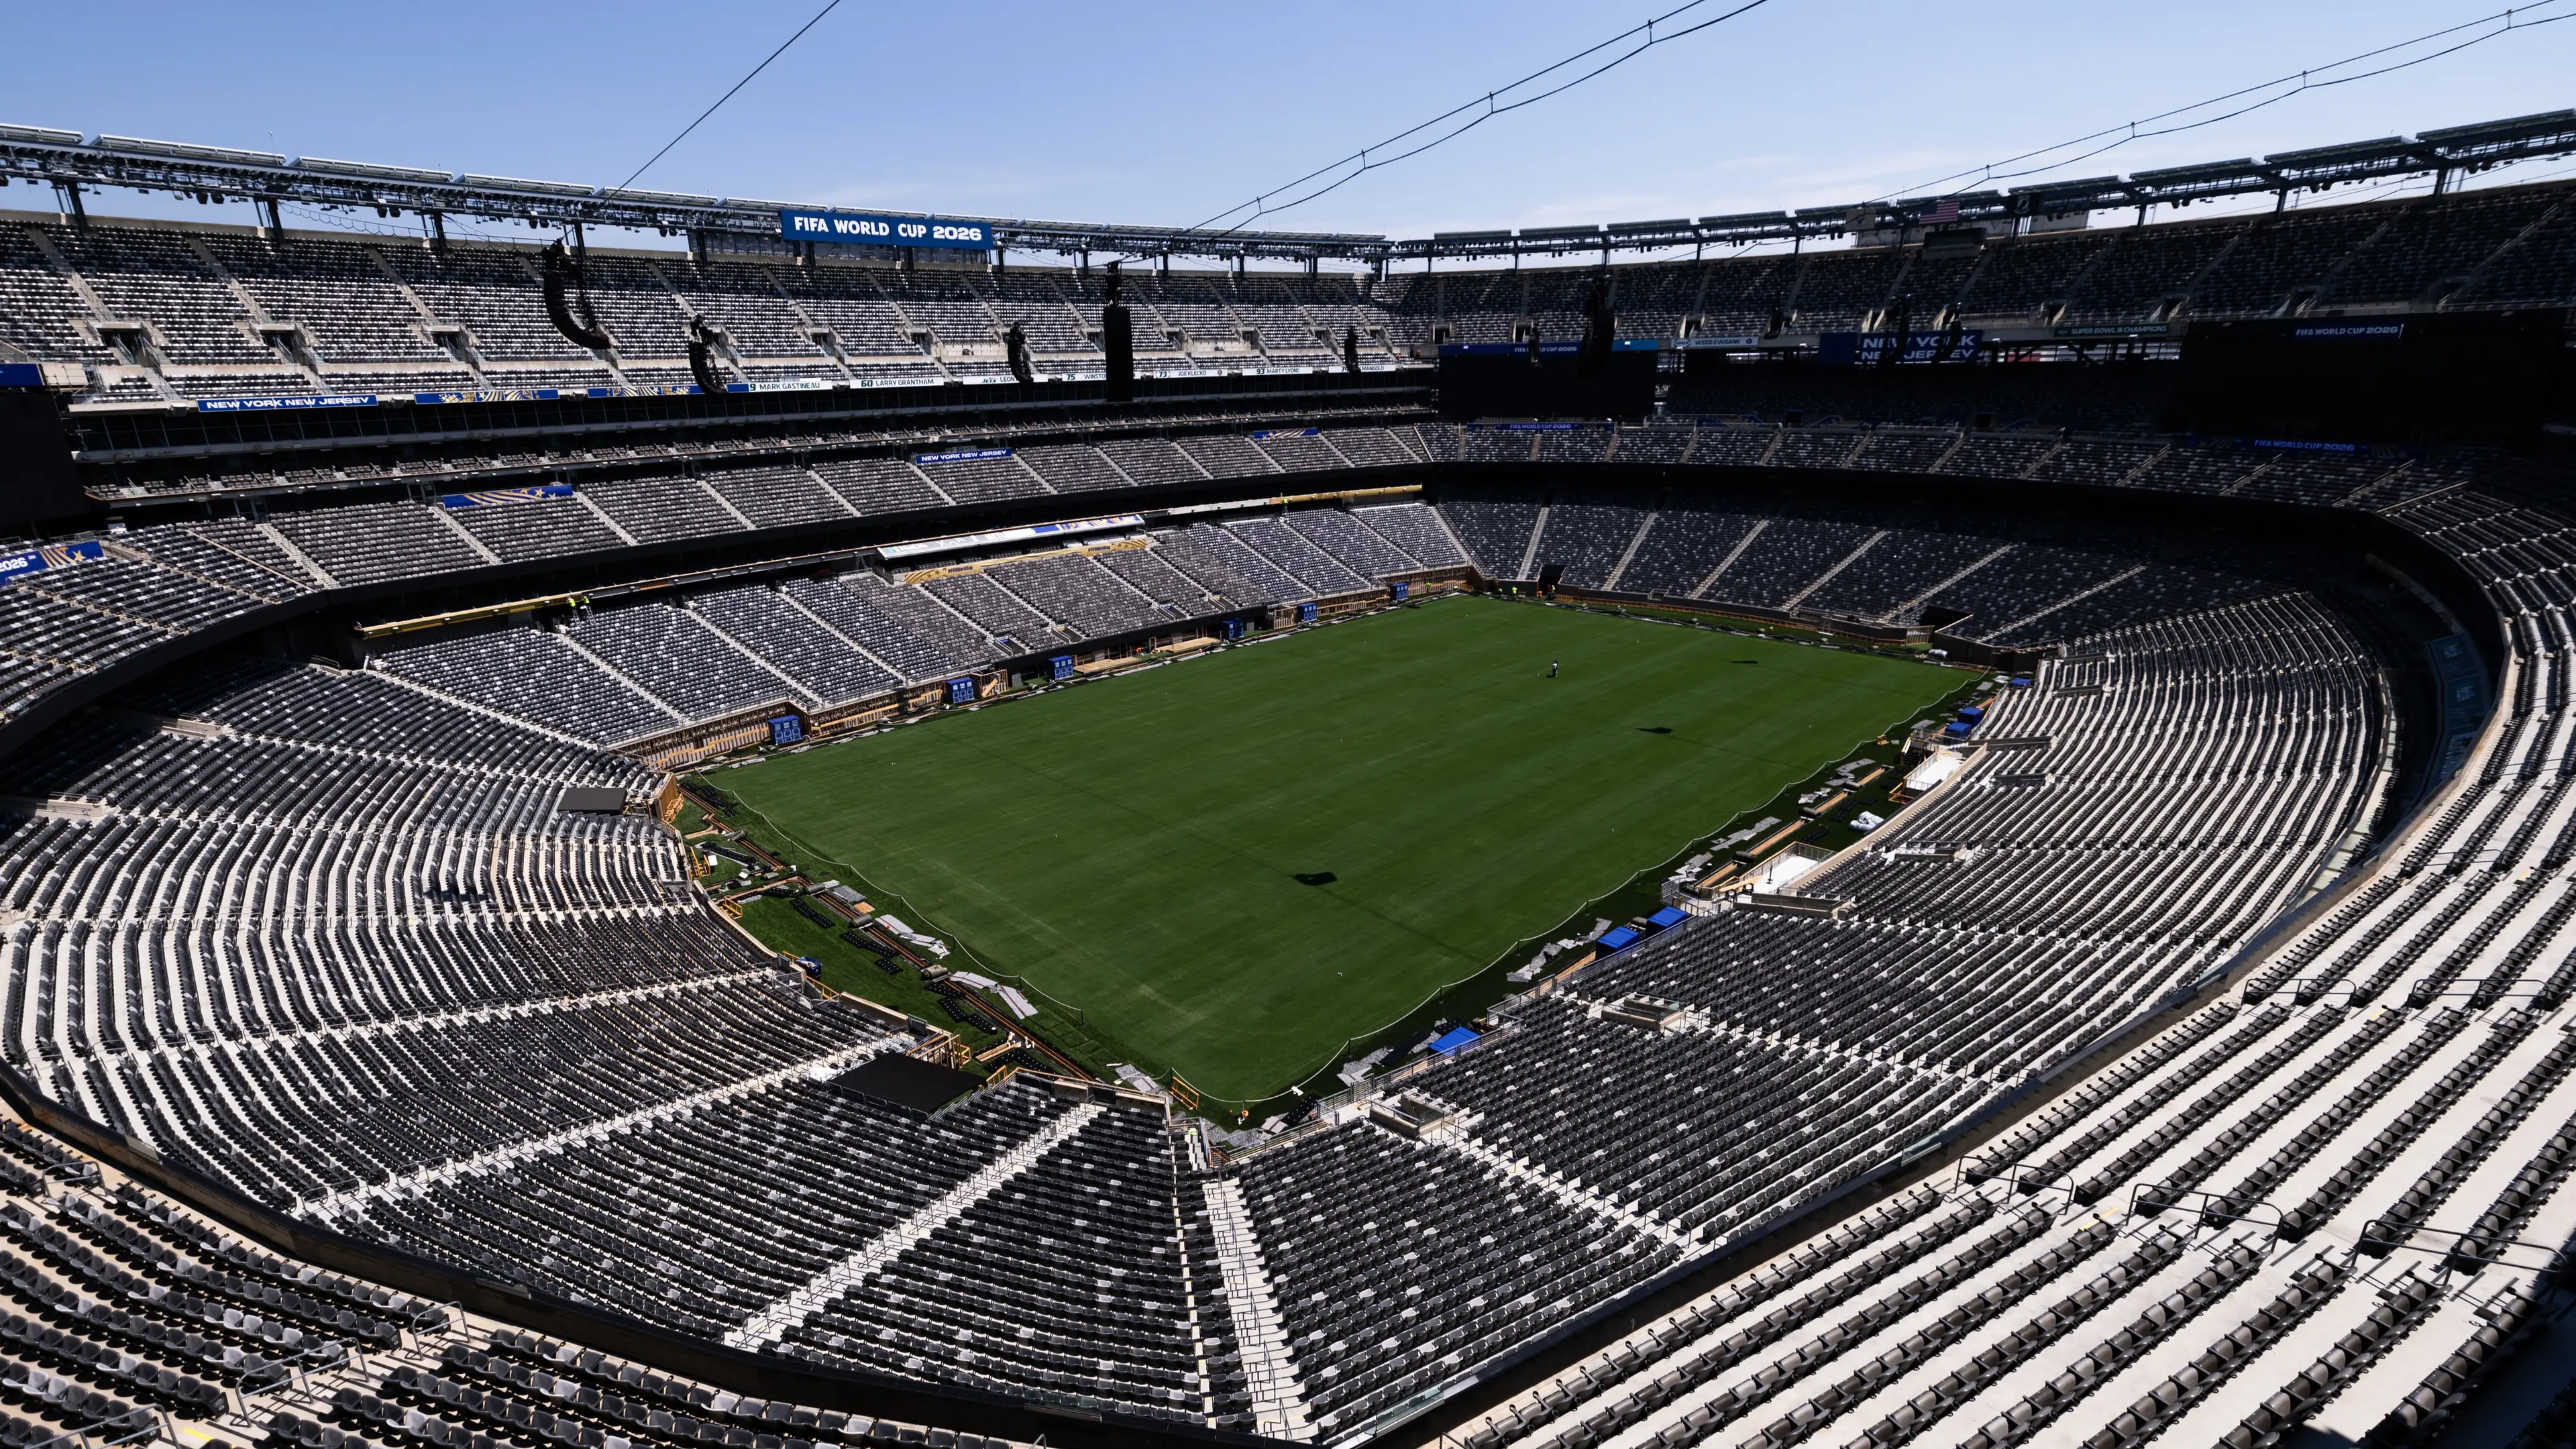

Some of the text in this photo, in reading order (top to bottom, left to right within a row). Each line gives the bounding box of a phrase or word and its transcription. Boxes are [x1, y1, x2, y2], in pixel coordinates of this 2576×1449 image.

[794, 216, 982, 241] FIFA WORLD CUP 2026
[2123, 325, 2167, 333] CHAMPIONS
[2315, 327, 2346, 335] WORLD
[2347, 327, 2365, 335] CUP
[2365, 326, 2398, 334] 2026
[1903, 348, 1975, 360] JEREY
[207, 396, 369, 409] NEW YORK NEW JERSEY
[2273, 441, 2303, 449] WORLD
[2322, 443, 2355, 451] 2026
